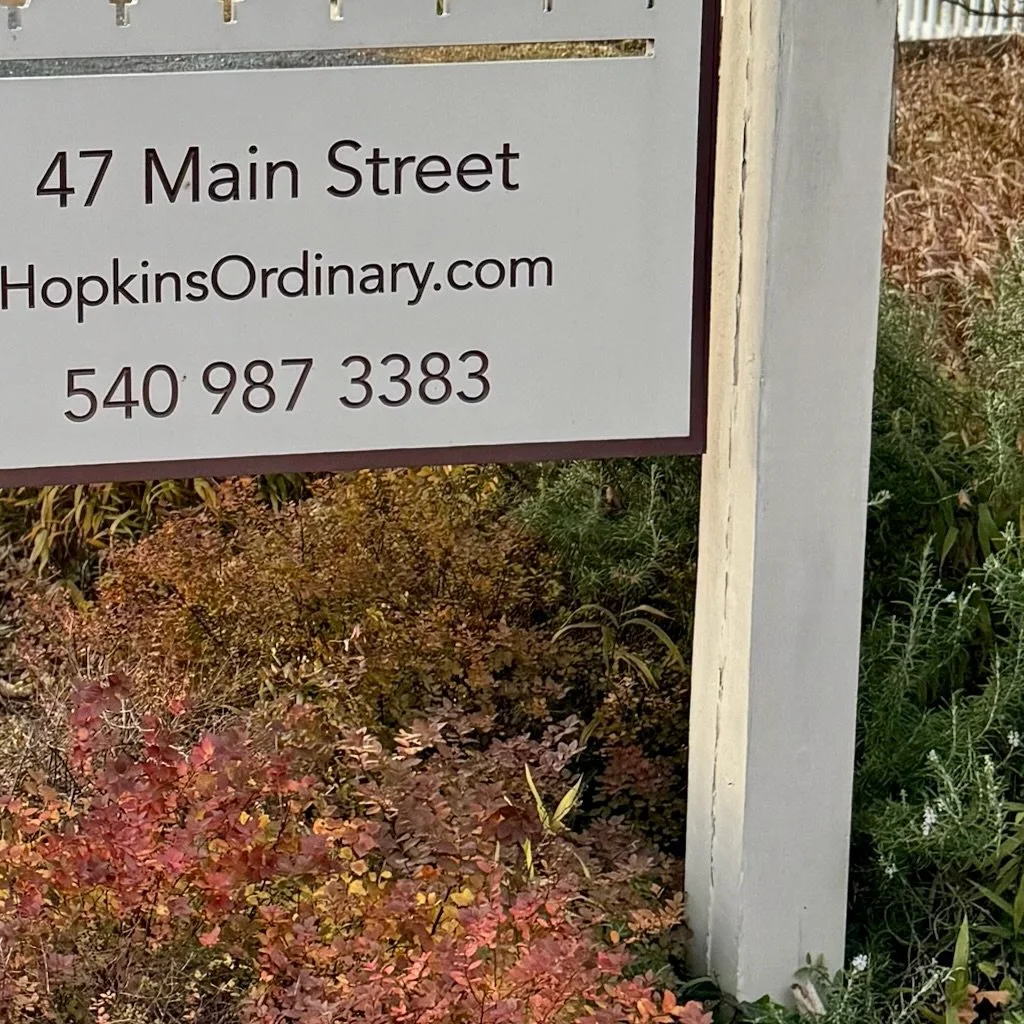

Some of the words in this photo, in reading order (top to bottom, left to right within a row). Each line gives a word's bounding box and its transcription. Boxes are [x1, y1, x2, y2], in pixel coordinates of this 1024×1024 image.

[36, 149, 113, 208] 47
[144, 145, 300, 205] Main
[326, 139, 521, 198] Street
[0, 249, 554, 324] HopkinsOrdinary.com
[63, 364, 179, 423] 540
[201, 357, 314, 415] 987
[339, 349, 491, 409] 3383
